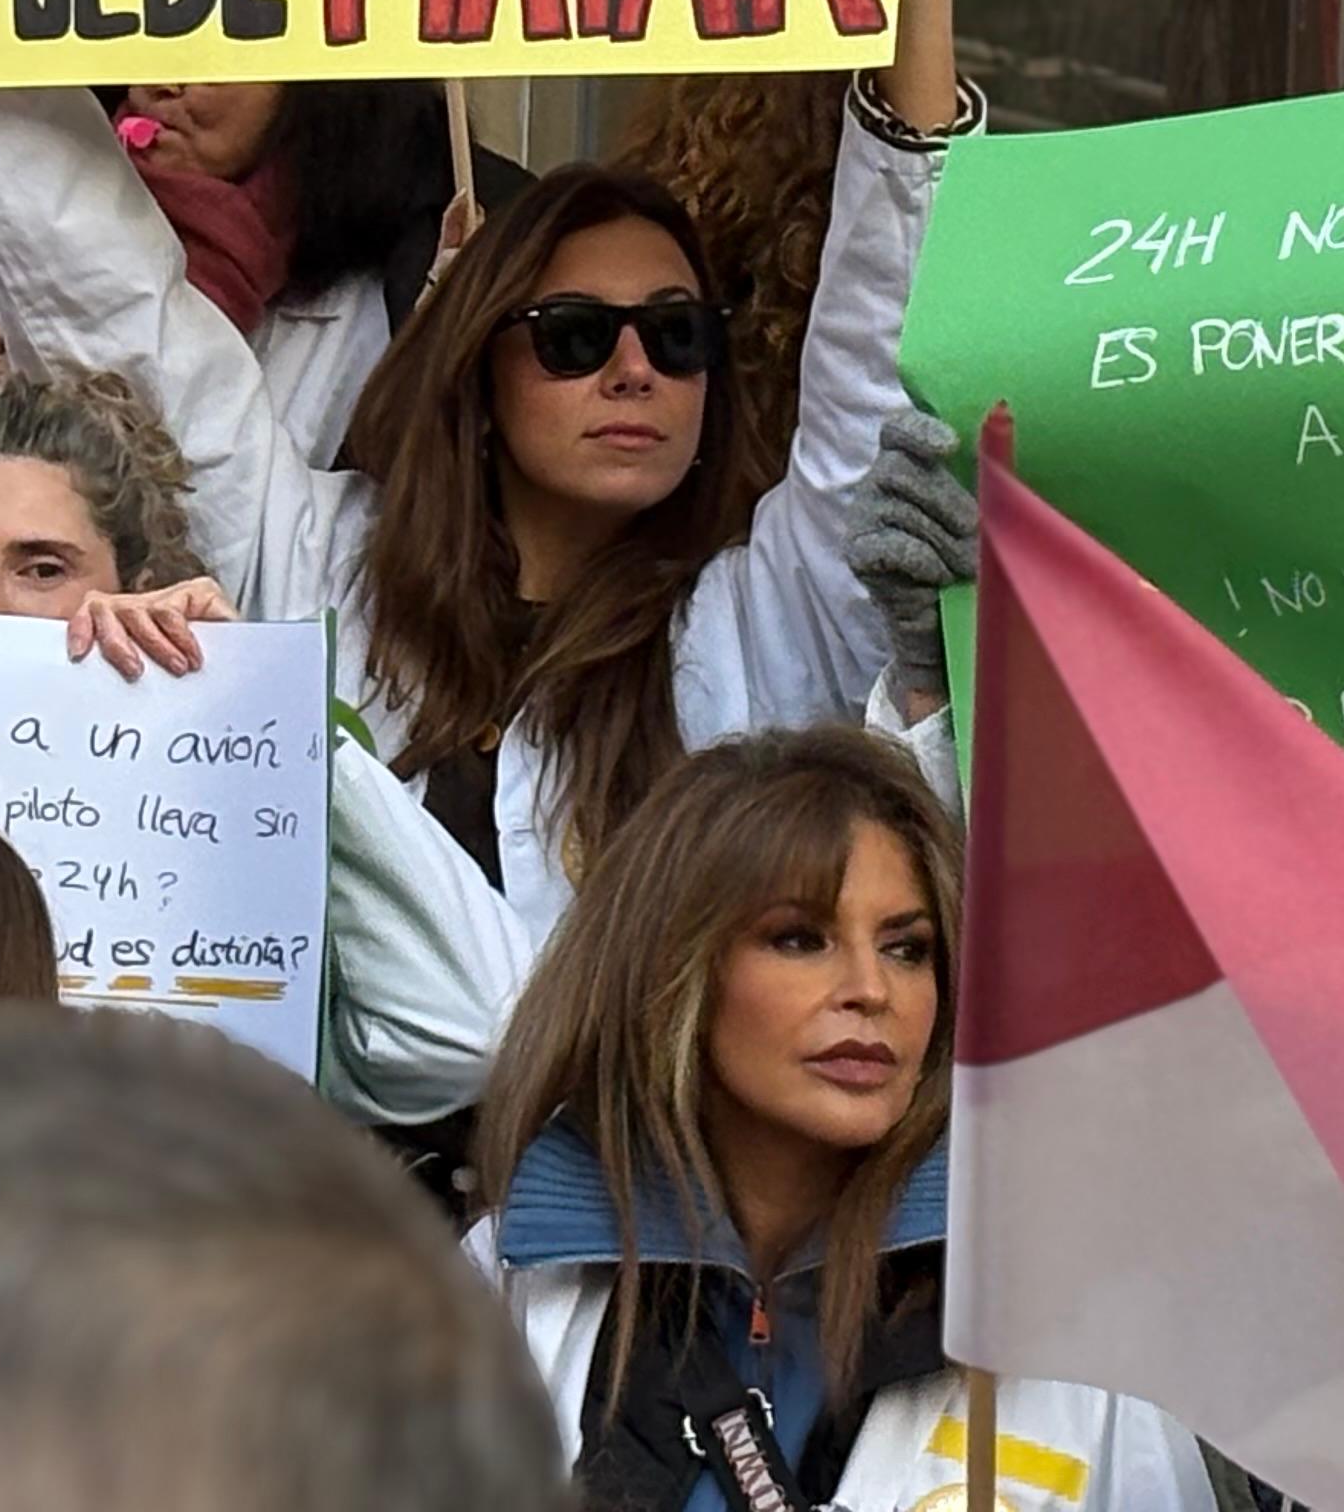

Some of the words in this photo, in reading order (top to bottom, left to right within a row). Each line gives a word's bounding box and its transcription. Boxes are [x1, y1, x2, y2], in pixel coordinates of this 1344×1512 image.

[1064, 212, 1226, 285] 24H
[1091, 327, 1158, 389] ES
[1296, 404, 1343, 465] A
[1261, 571, 1326, 616] NO
[10, 716, 50, 752] a
[90, 722, 142, 761] un
[168, 719, 282, 769] avión
[5, 786, 101, 839] piloto
[136, 794, 220, 845] lleva
[254, 803, 299, 839] sin
[111, 938, 156, 967] es
